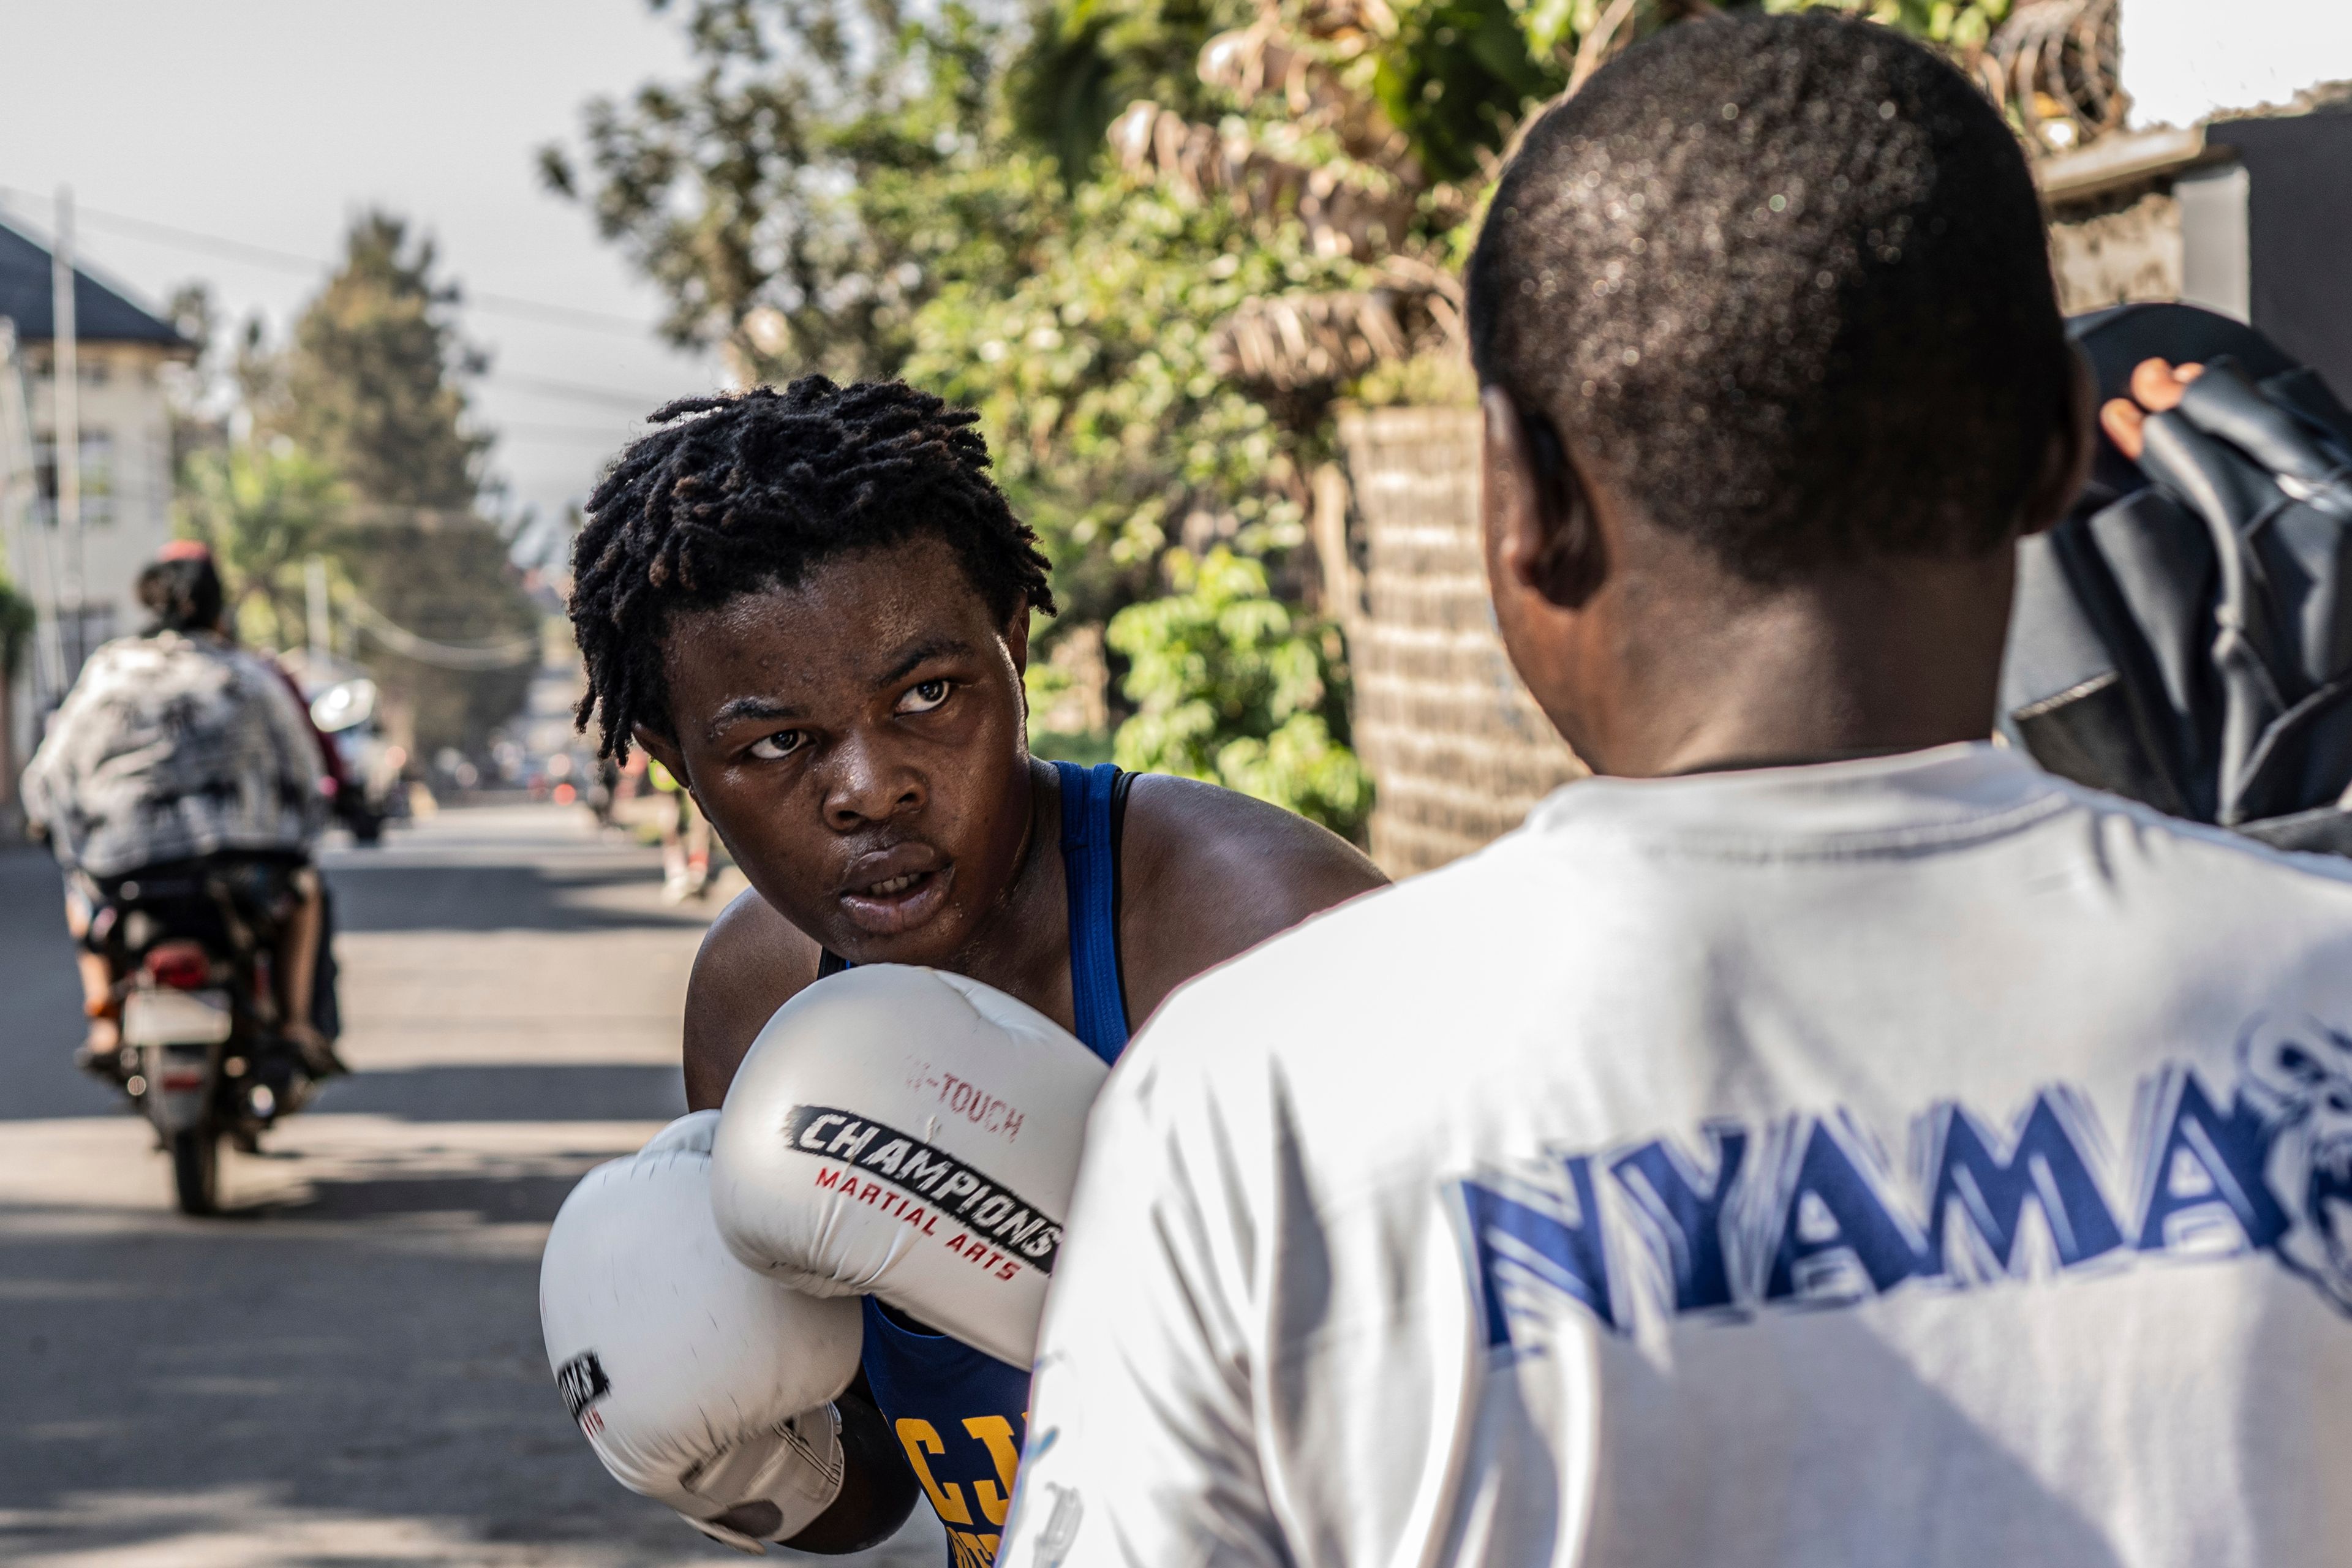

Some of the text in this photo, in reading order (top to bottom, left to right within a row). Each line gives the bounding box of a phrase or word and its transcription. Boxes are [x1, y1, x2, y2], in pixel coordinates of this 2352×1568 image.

[798, 1112, 1064, 1257] CHAMPIONS
[815, 1167, 1022, 1281] MARTIAL ARTS
[895, 1411, 1029, 1526] CJ
